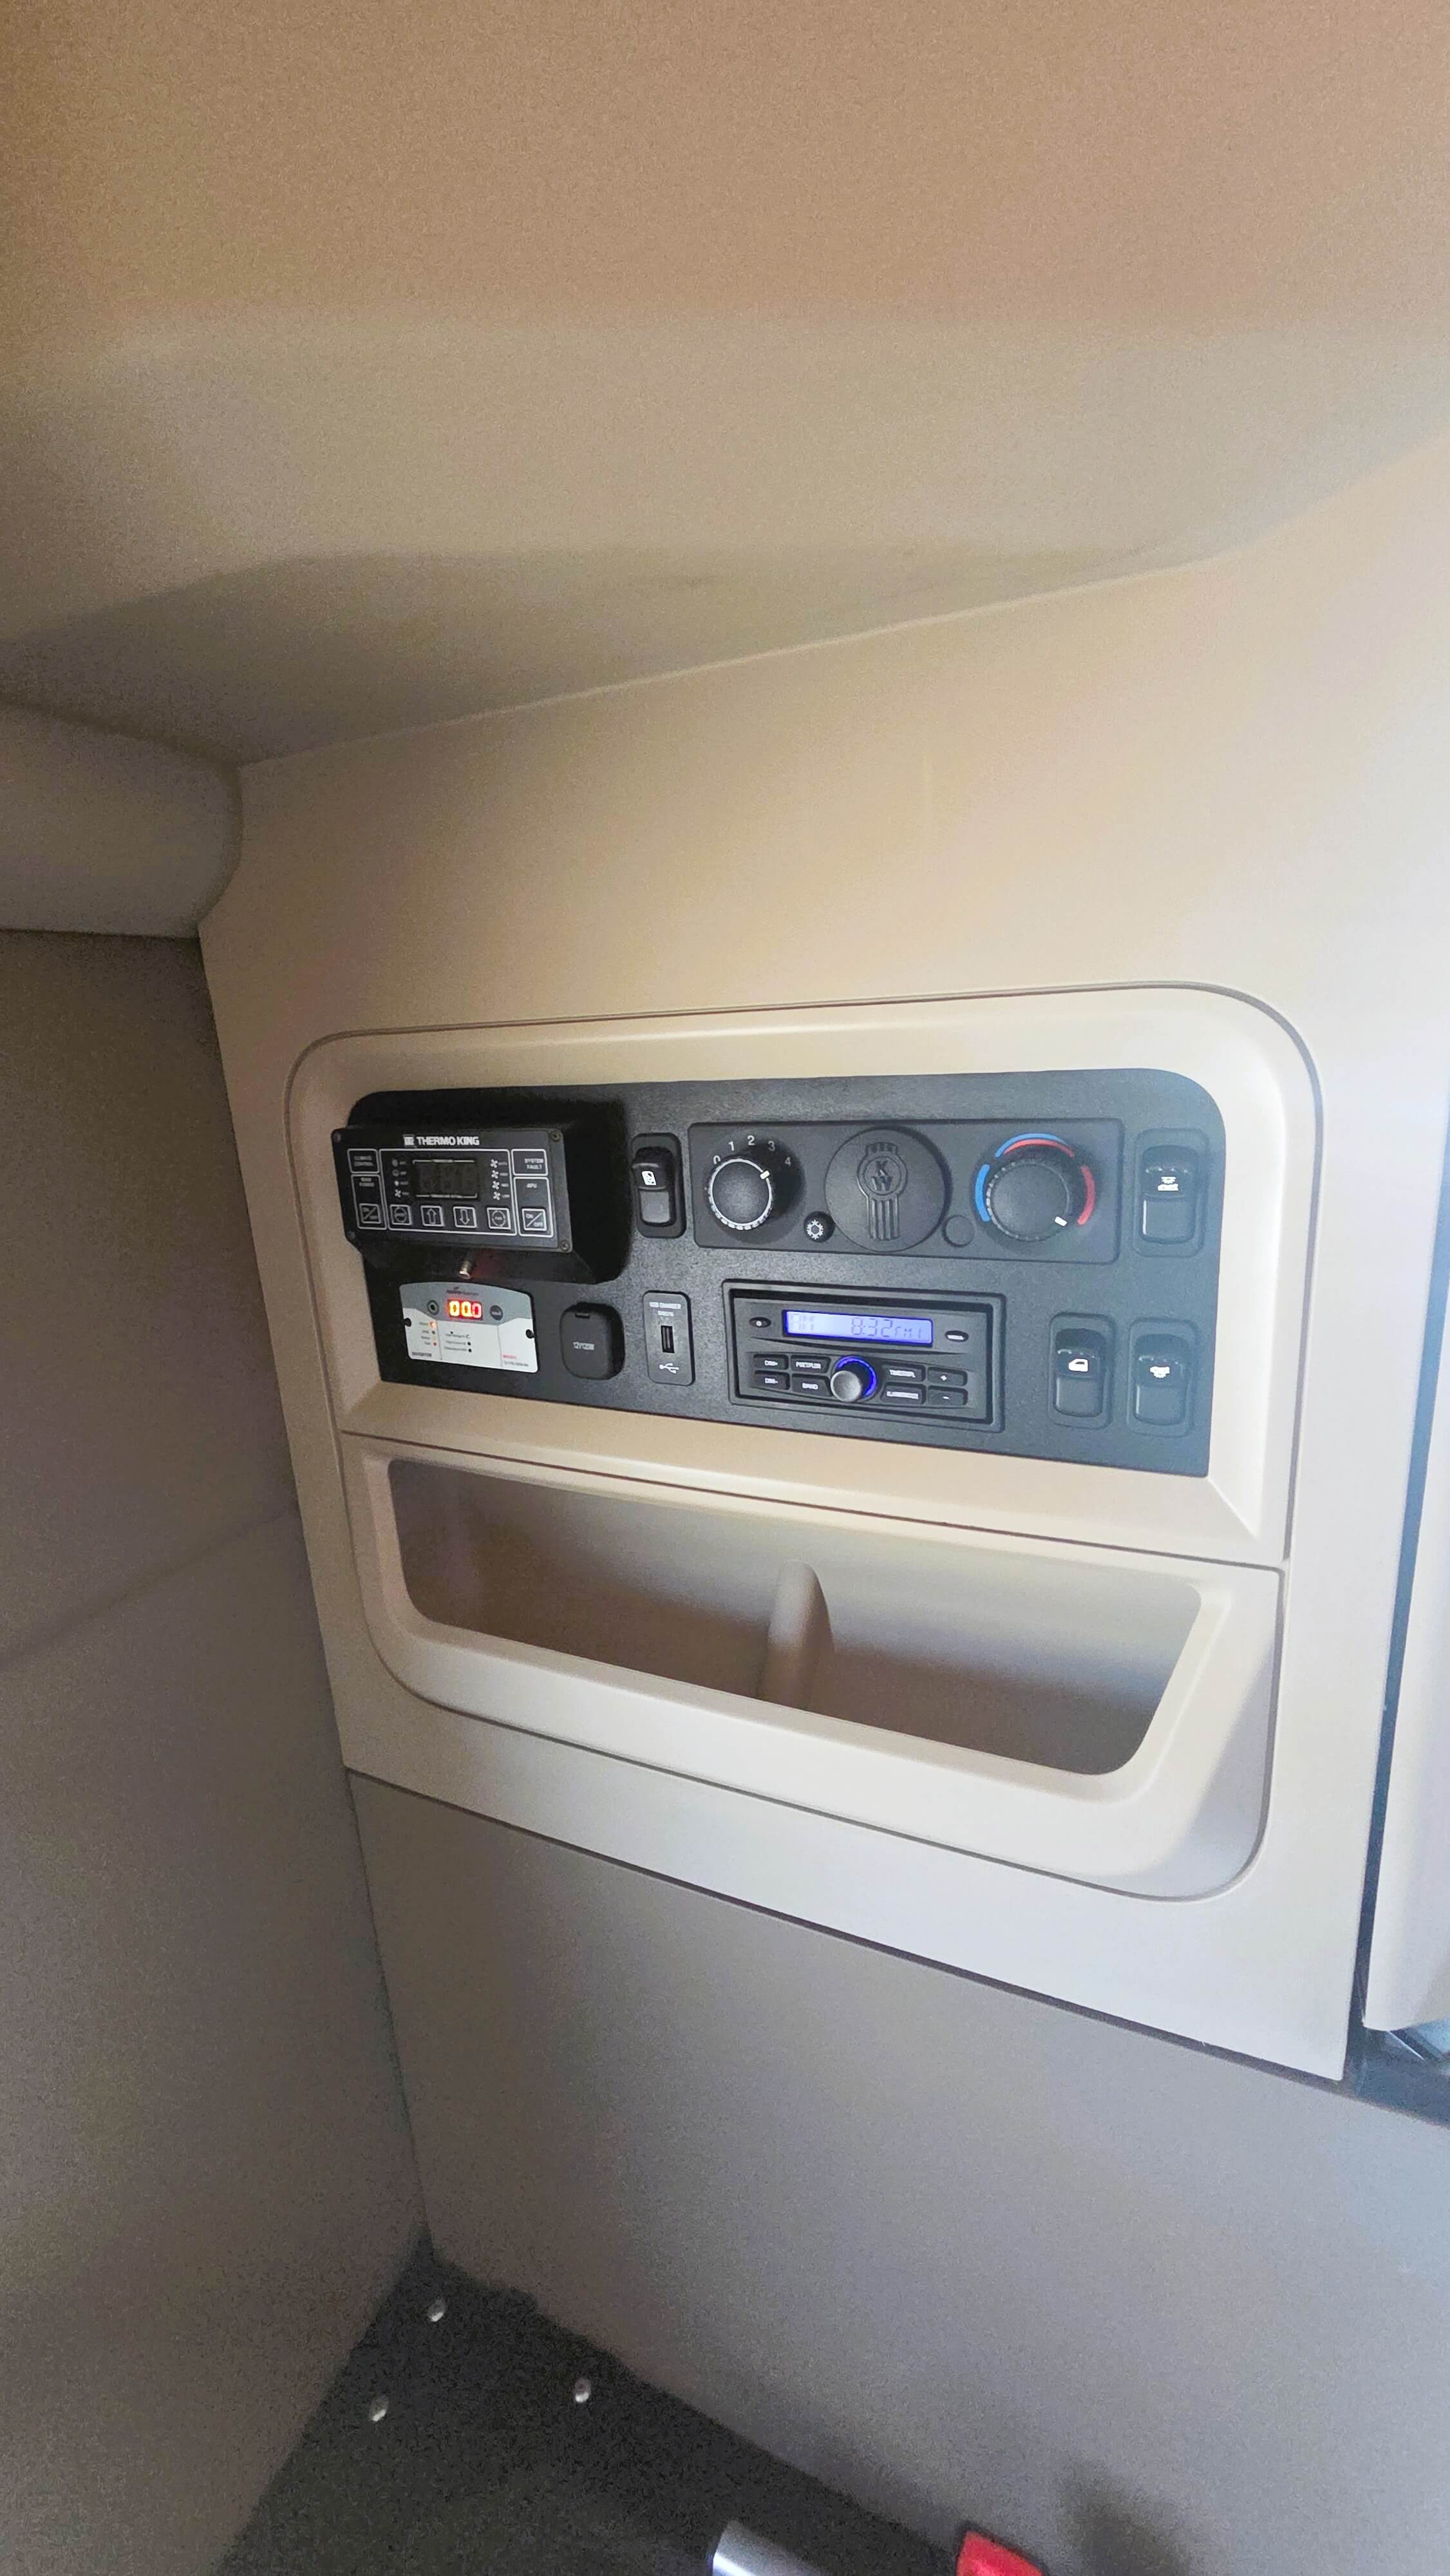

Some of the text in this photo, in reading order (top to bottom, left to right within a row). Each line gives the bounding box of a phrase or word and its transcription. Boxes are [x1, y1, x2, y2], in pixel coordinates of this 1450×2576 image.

[416, 1136, 480, 1146] THERMO KING
[728, 1141, 735, 1151] 1
[747, 1135, 755, 1146] 2
[767, 1141, 775, 1151] 3
[784, 1157, 791, 1166] 4
